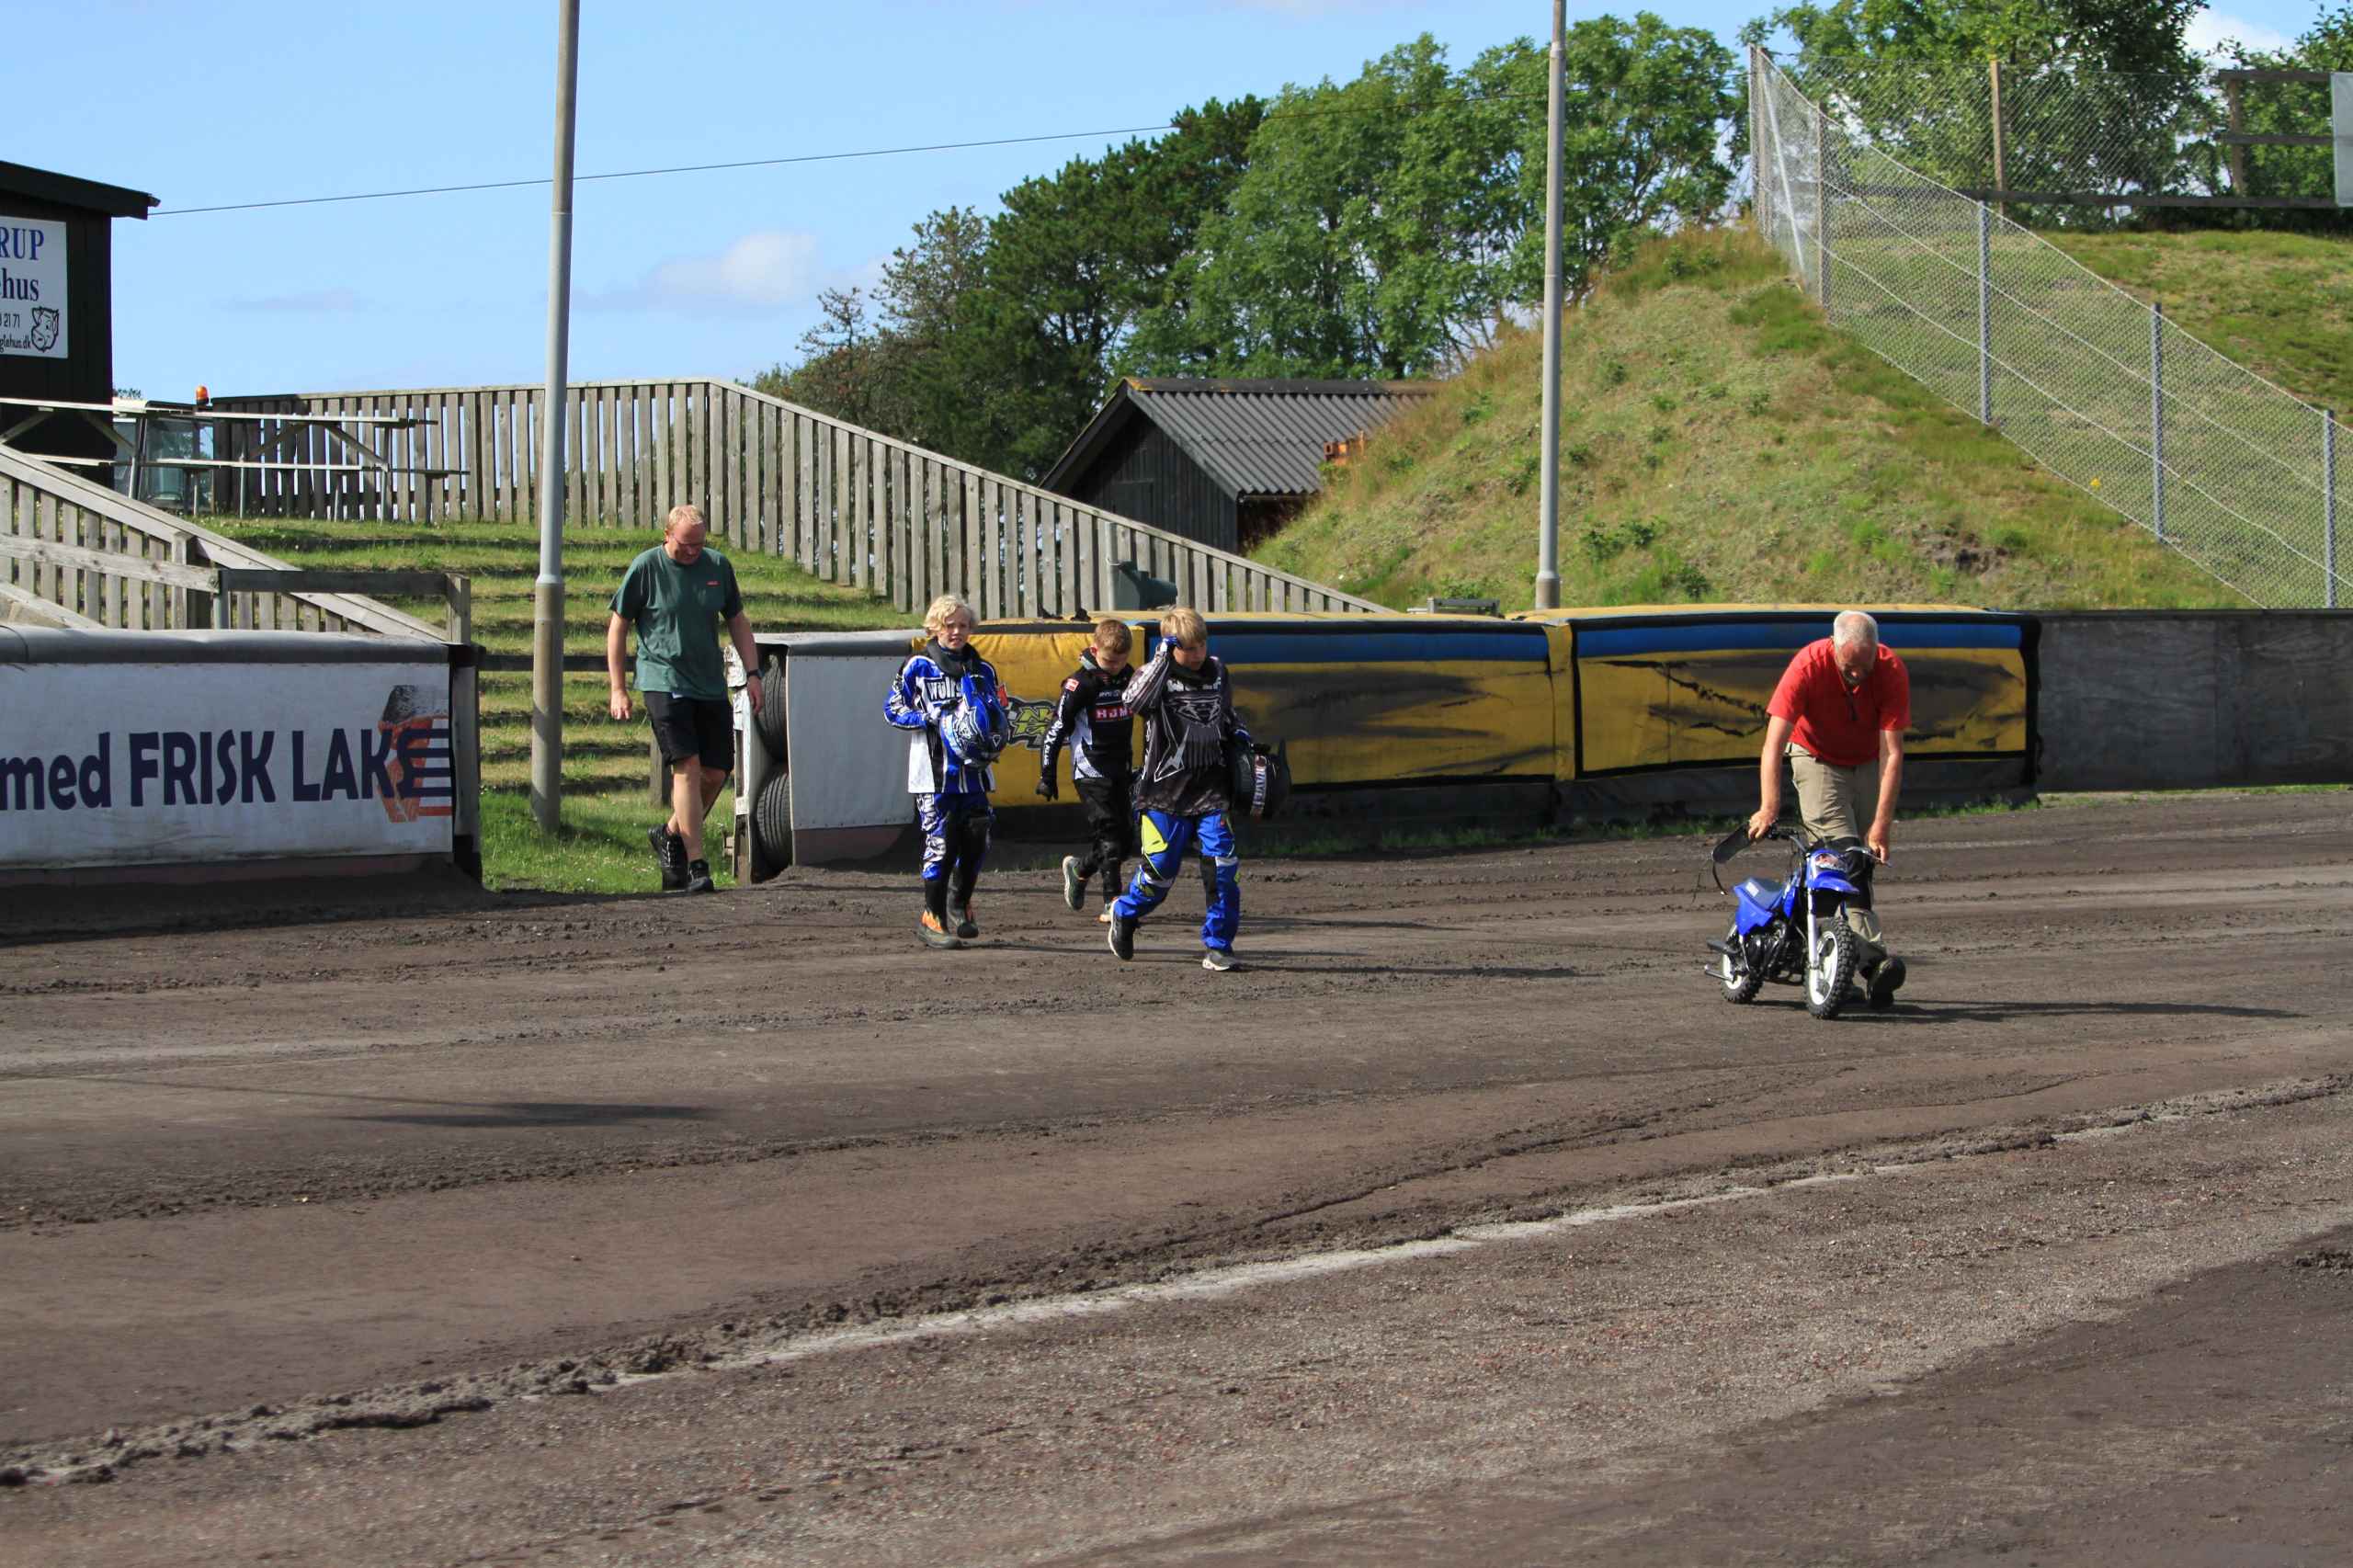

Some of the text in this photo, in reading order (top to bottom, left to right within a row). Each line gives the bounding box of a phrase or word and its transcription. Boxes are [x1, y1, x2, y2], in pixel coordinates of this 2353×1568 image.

[0, 267, 39, 301] hus
[0, 732, 111, 811] med
[129, 729, 276, 807] FRISK
